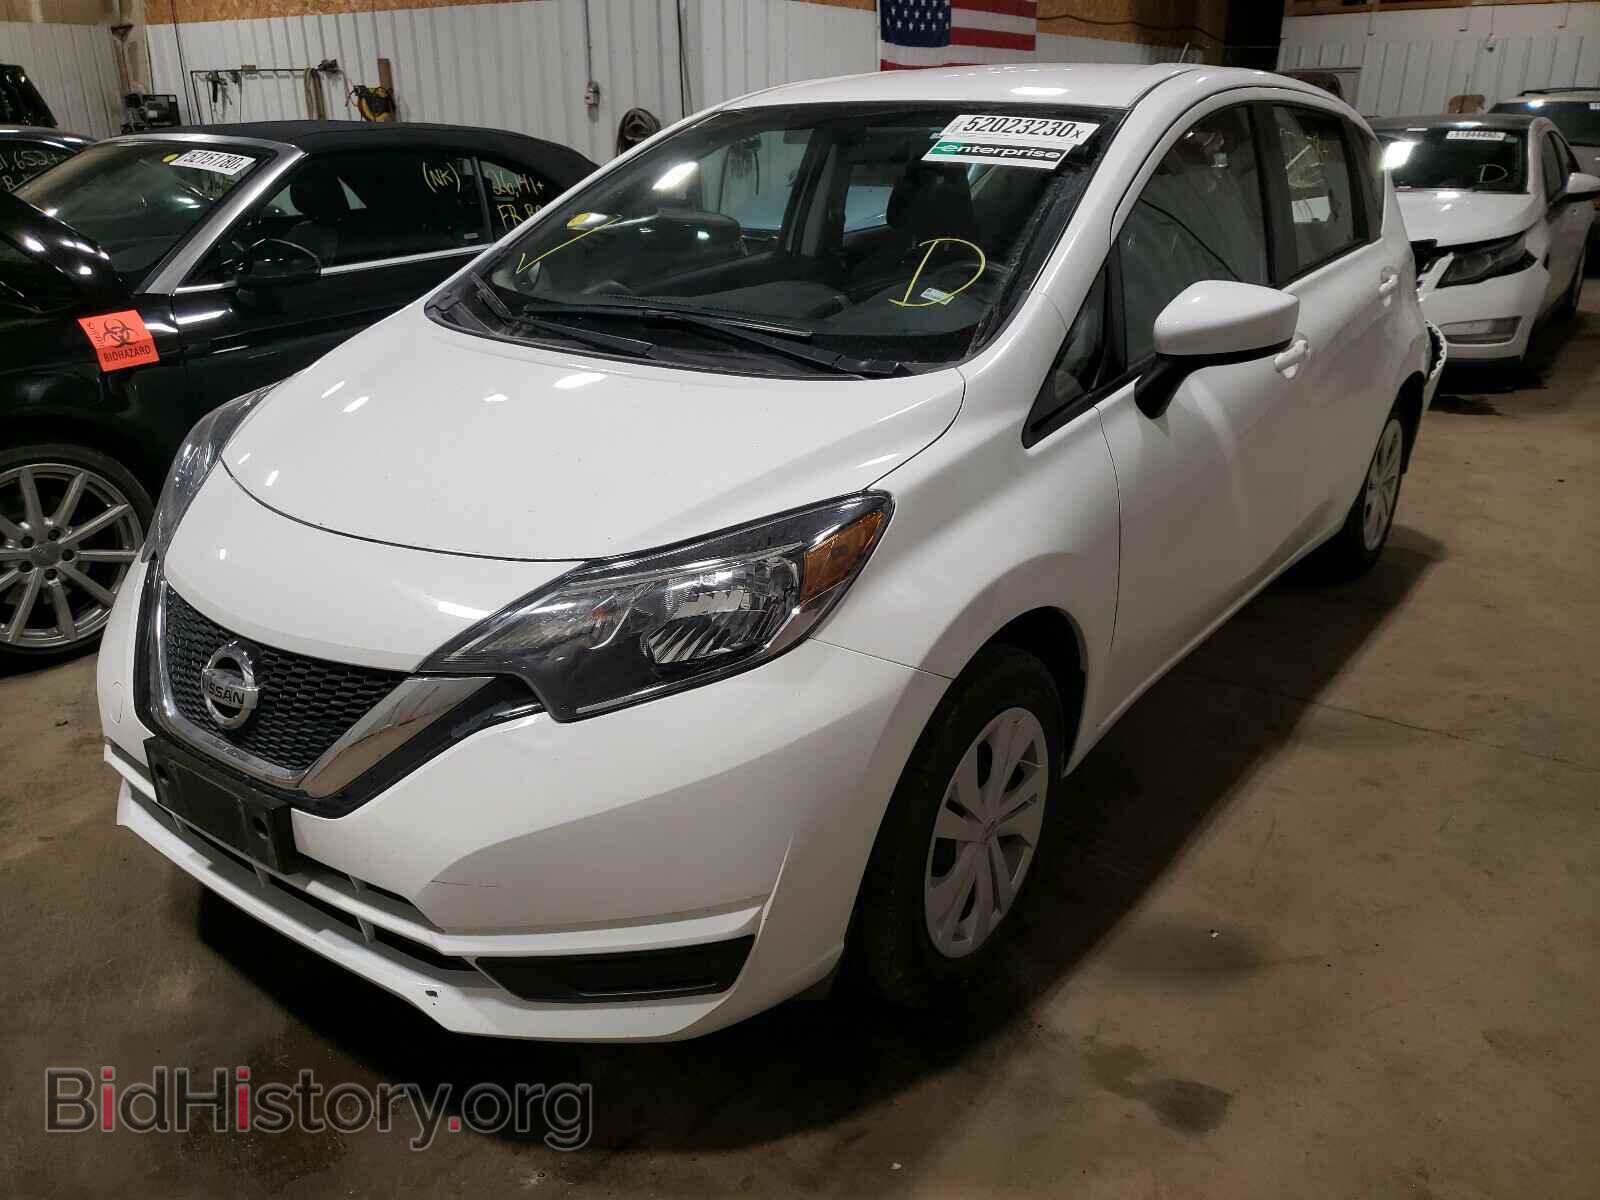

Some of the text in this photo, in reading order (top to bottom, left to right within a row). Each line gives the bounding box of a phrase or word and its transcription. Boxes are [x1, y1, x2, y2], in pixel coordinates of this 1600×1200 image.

[934, 144, 1061, 159] enterprise
[888, 238, 985, 307] D
[104, 345, 151, 361] BIOHAZARD
